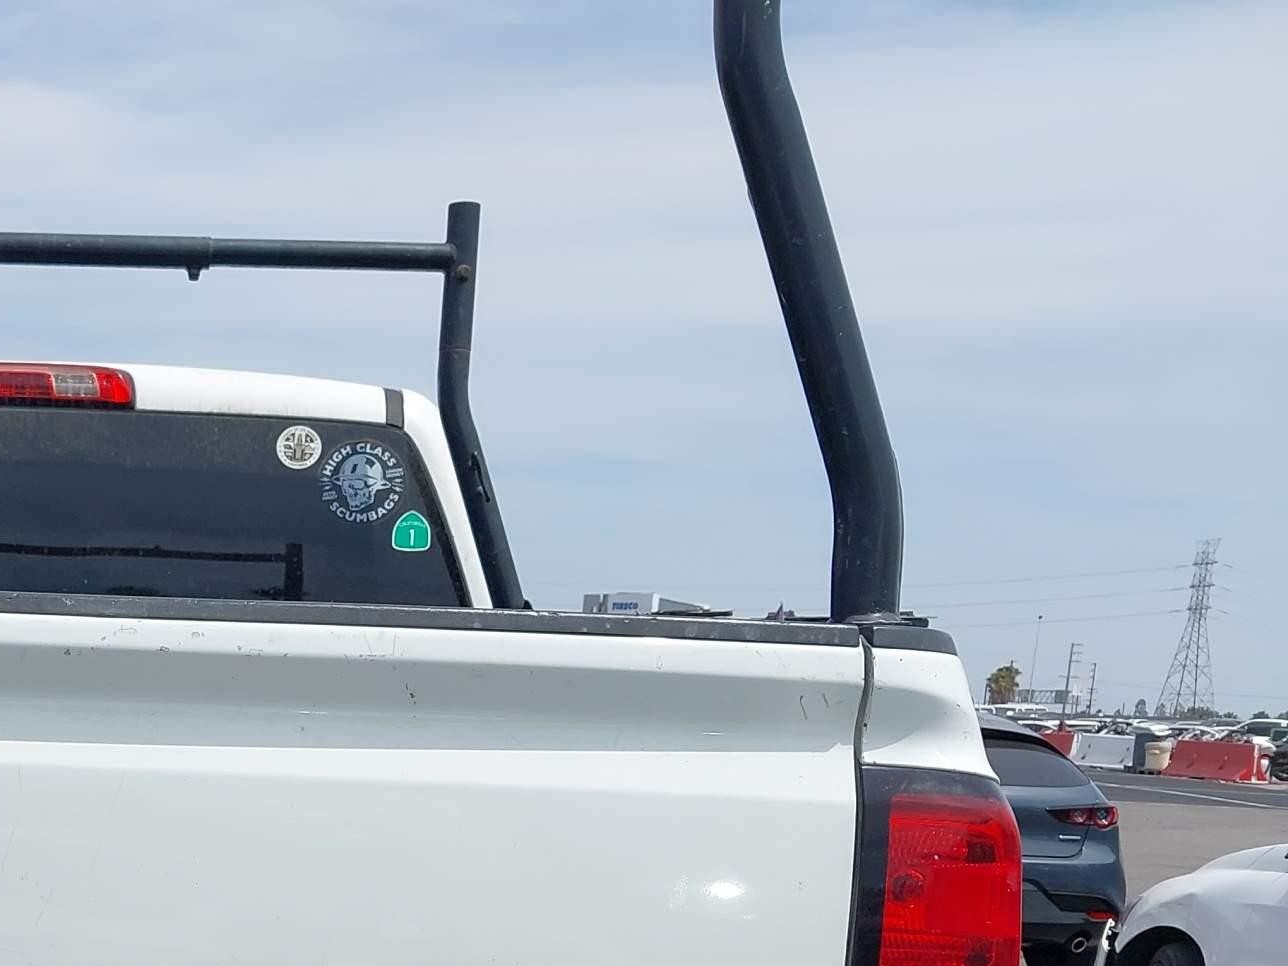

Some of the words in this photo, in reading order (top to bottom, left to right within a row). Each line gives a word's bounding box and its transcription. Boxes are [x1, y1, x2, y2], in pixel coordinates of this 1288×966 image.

[322, 446, 352, 476] HIGH
[356, 443, 397, 467] CLASS
[330, 493, 399, 522] SCUMBAGS
[409, 529, 415, 546] 1
